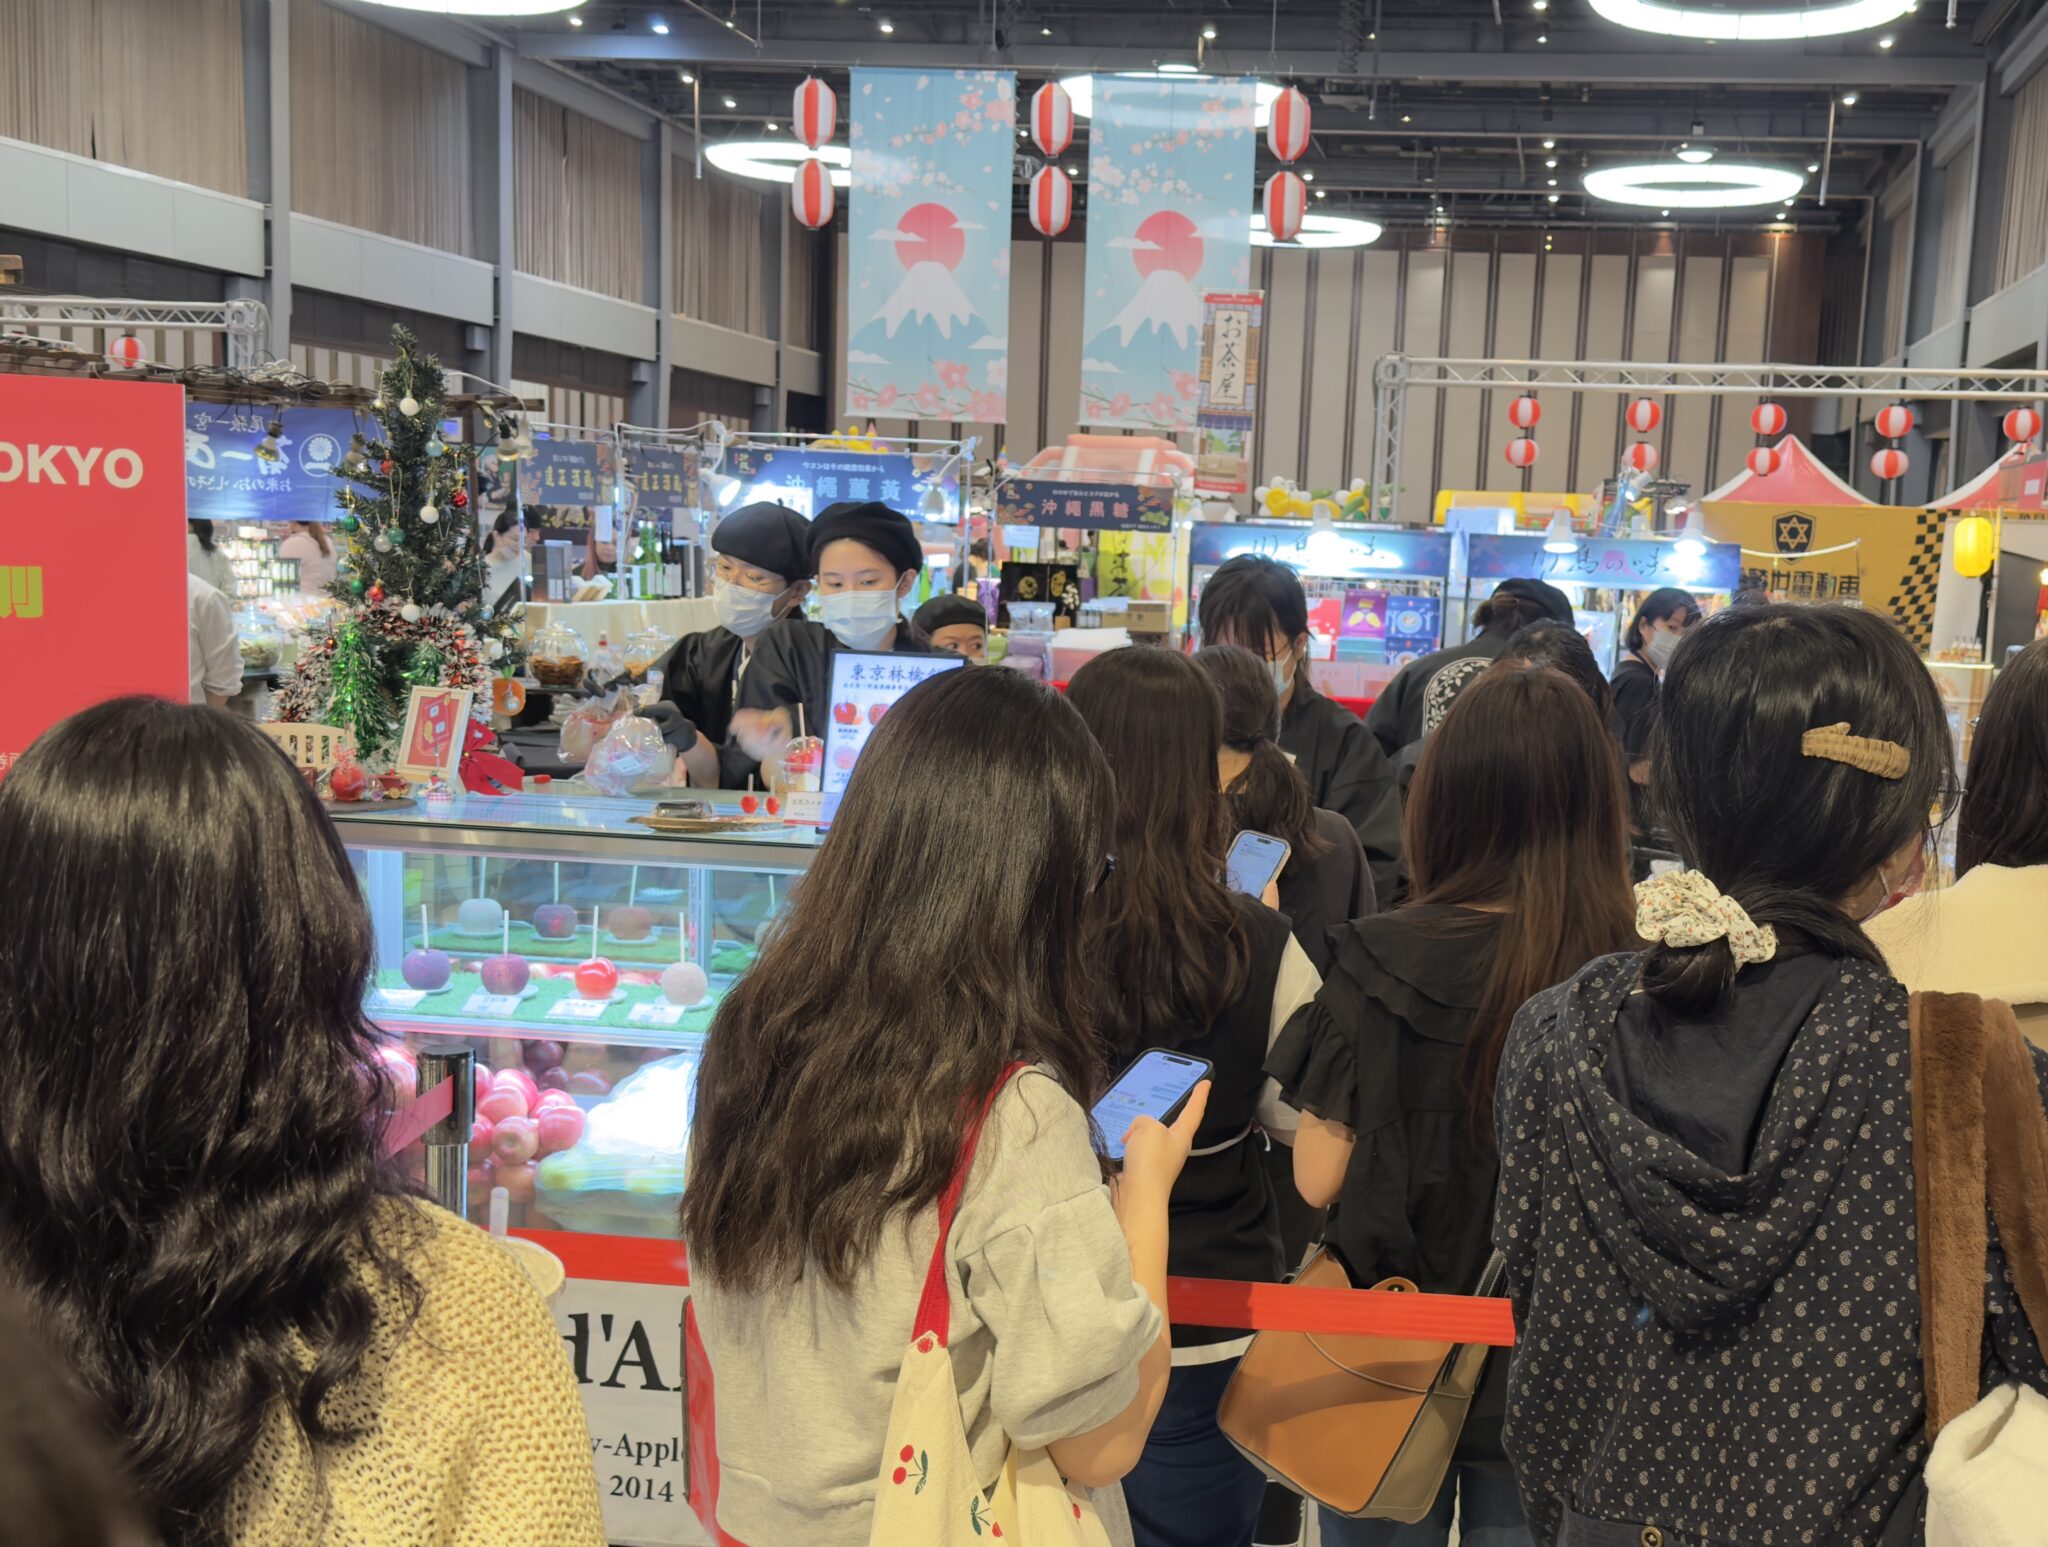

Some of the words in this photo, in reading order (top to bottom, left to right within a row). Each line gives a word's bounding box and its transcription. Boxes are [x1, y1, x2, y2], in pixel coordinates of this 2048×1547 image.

[1213, 313, 1242, 400] お茶屋
[562, 1312, 682, 1392] d'A
[609, 1474, 674, 1503] 2014
